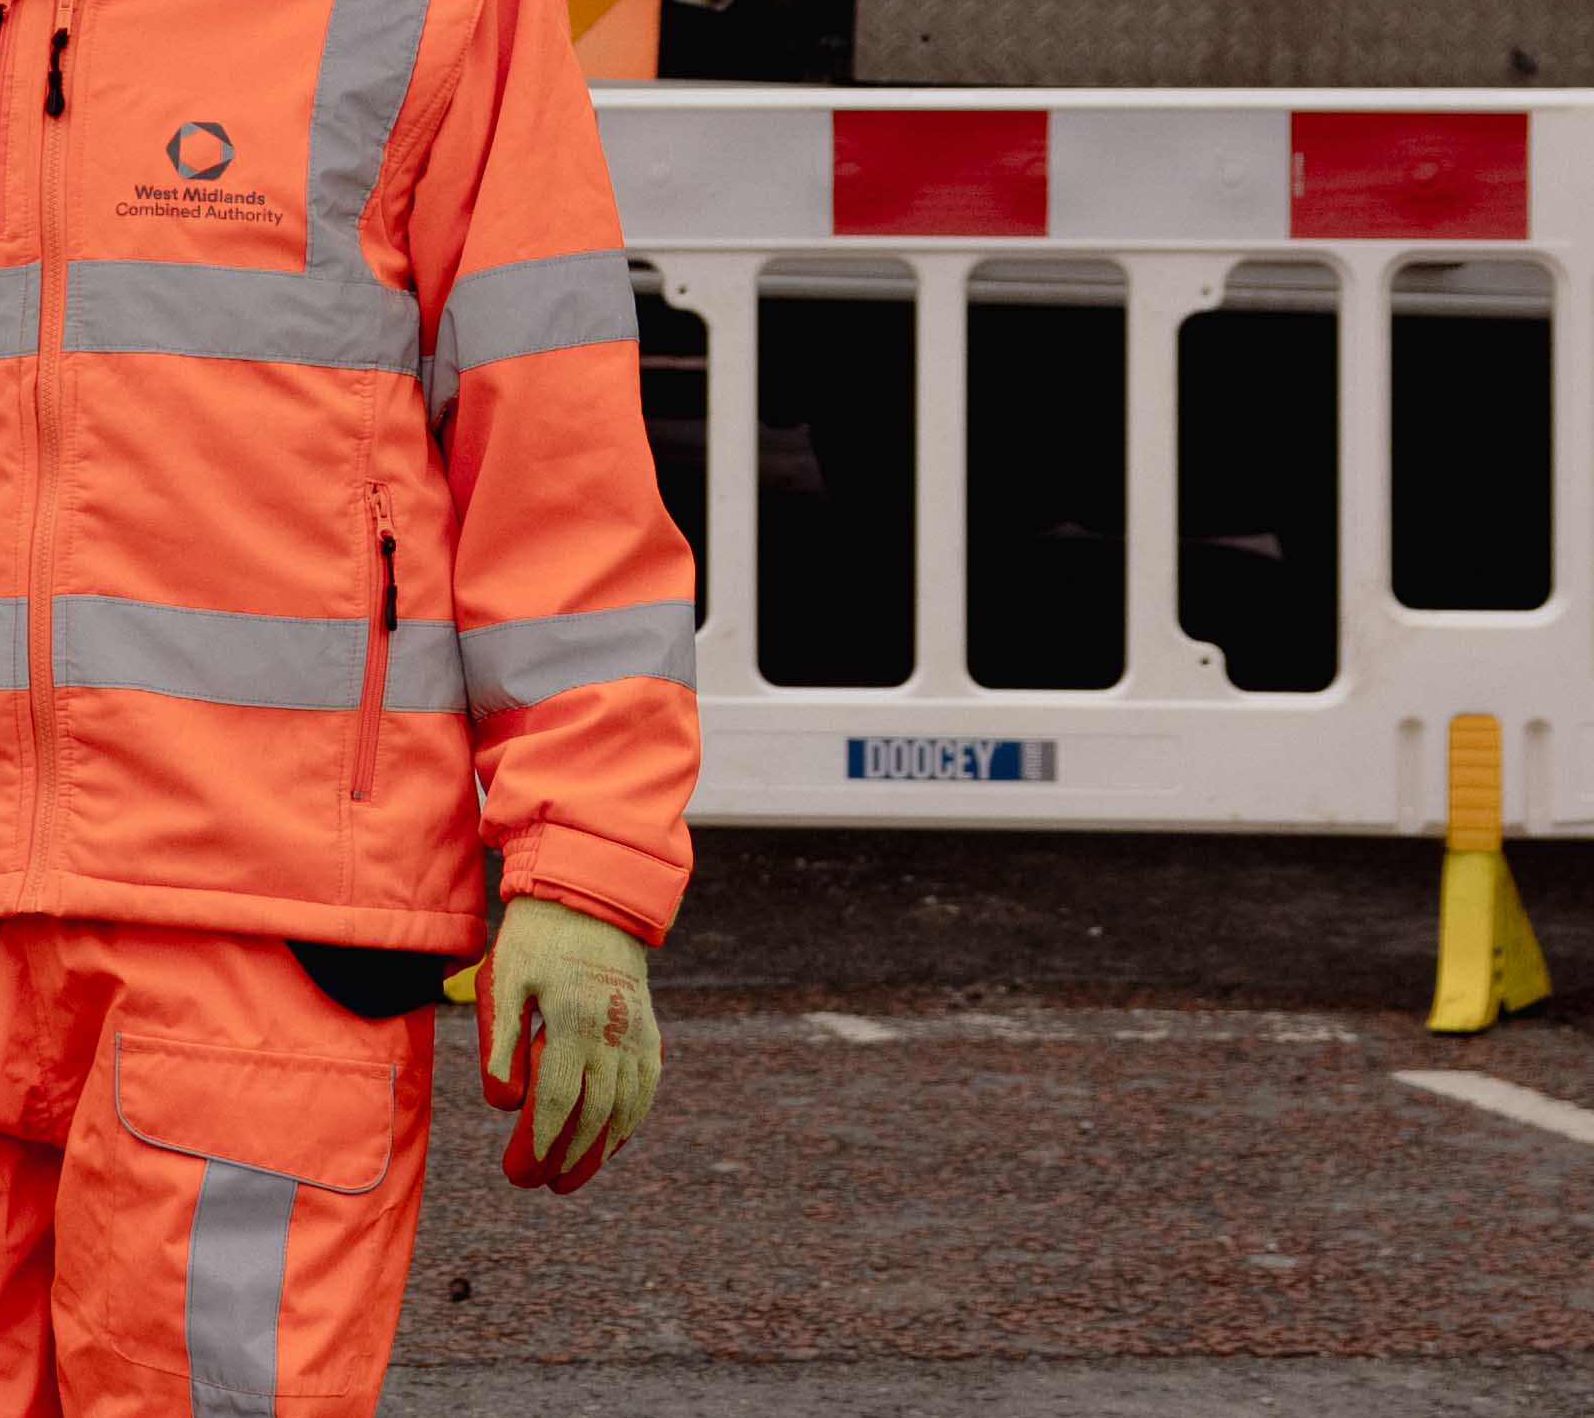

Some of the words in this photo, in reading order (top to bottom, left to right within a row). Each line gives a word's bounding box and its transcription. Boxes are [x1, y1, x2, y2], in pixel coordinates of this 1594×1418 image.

[135, 185, 179, 201] West
[182, 187, 266, 206] Midlands
[115, 202, 202, 219] Combined
[205, 204, 284, 226] Authority
[866, 740, 996, 781] DOOCEY
